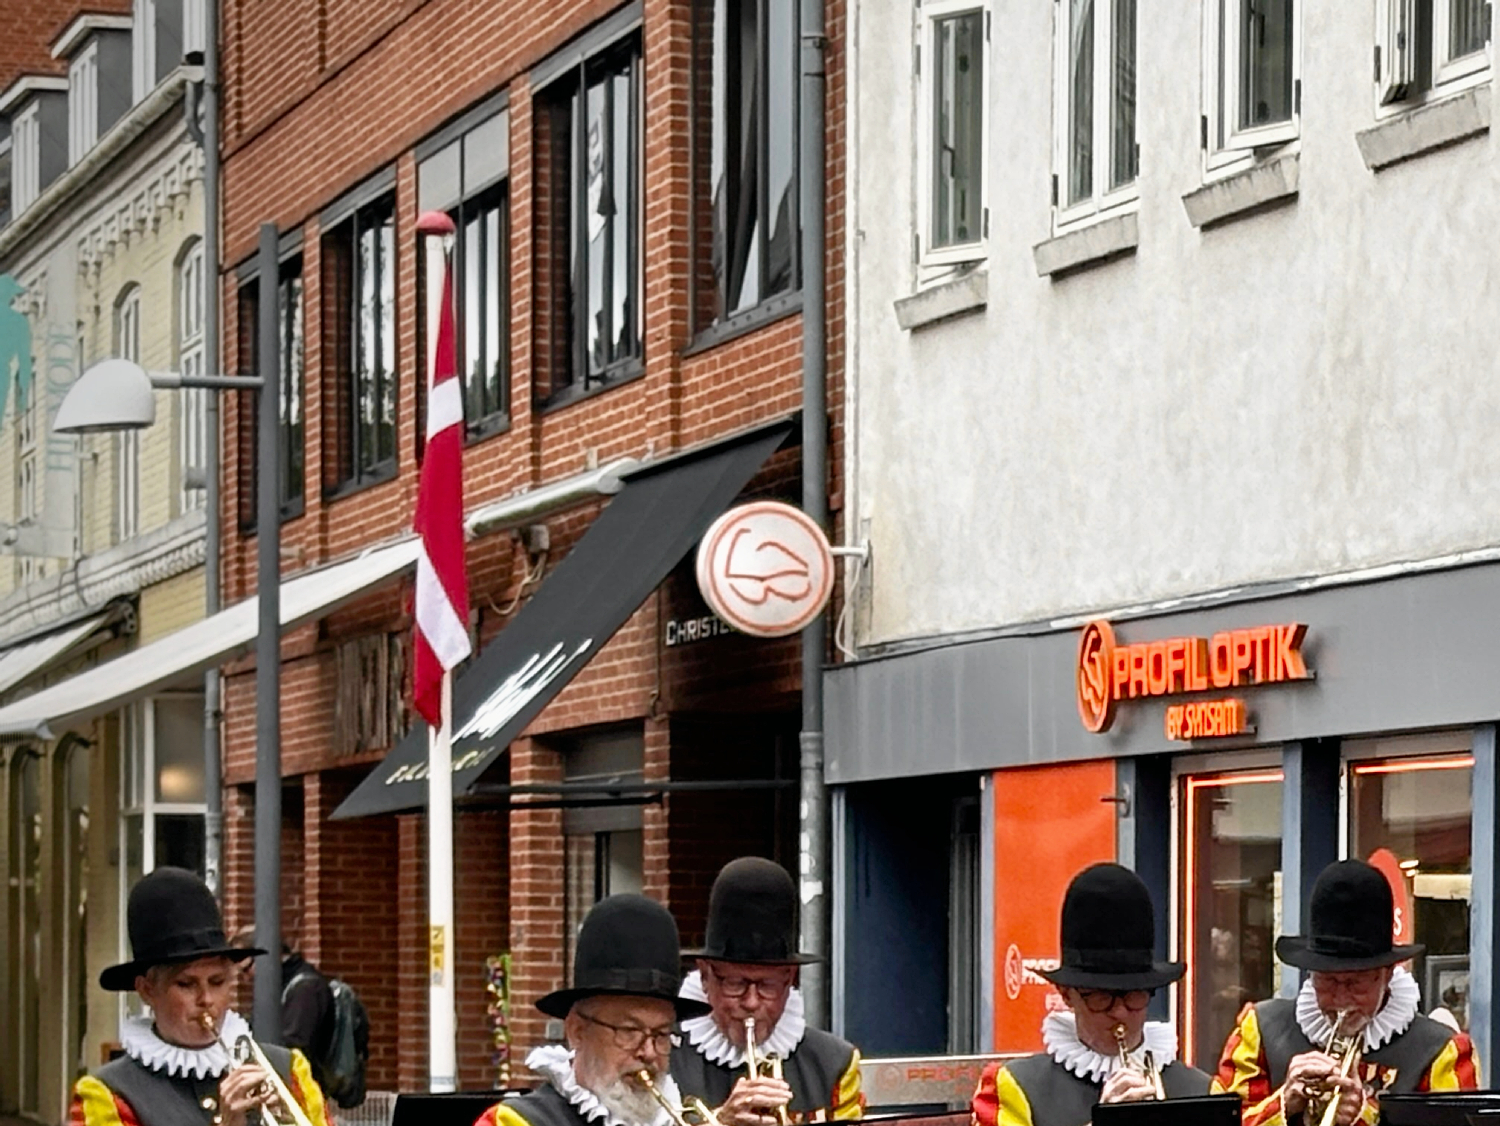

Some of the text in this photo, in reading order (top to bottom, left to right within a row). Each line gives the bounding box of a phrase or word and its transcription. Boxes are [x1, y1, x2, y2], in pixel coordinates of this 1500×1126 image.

[1114, 623, 1308, 700] PROFIL OPTIK
[1166, 698, 1245, 740] BY SYNSAM
